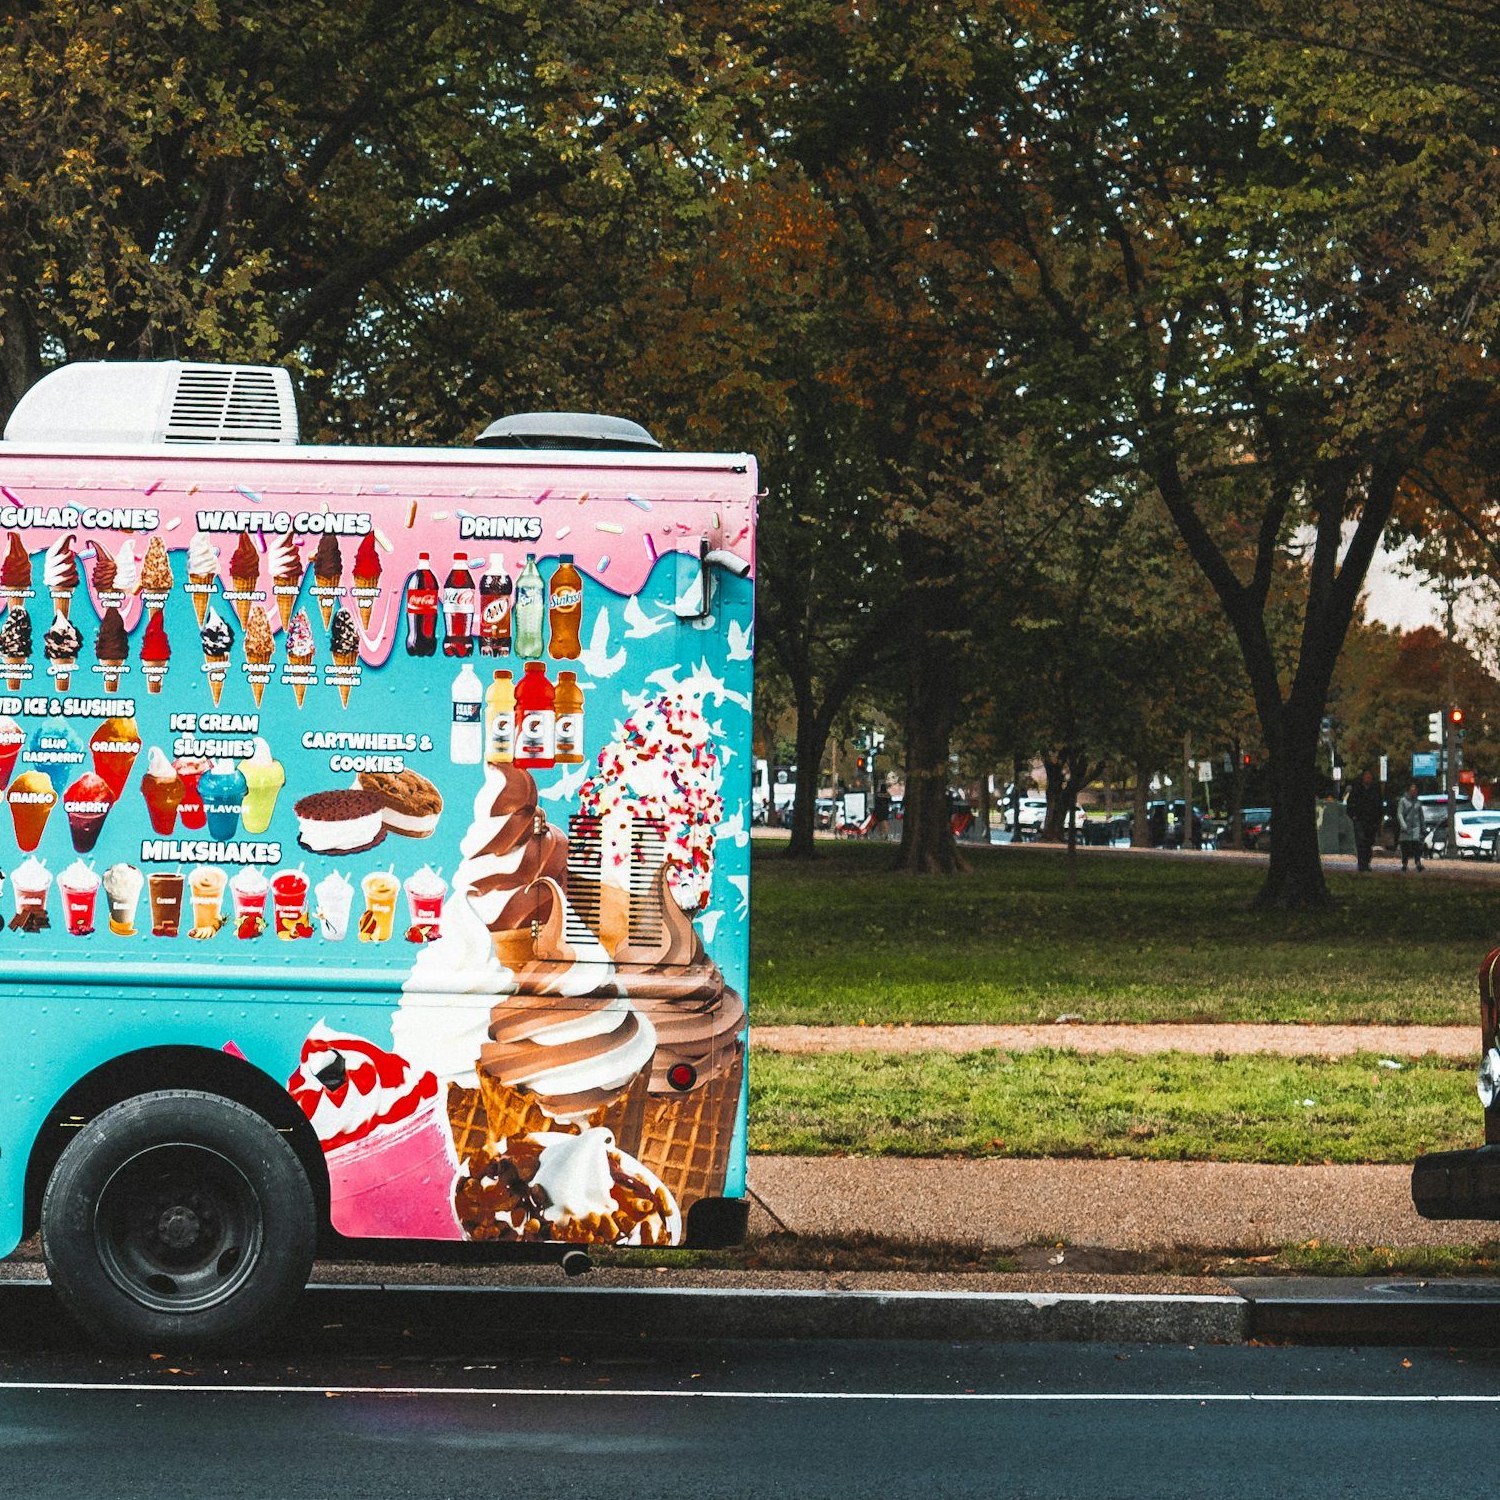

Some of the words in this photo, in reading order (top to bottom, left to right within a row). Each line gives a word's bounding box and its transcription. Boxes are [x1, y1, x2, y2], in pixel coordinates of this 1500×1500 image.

[82, 507, 159, 530] CONES
[293, 513, 371, 536] CONES
[460, 516, 542, 540] DRINKS
[184, 583, 218, 593] VANILLA
[223, 591, 266, 600] CHOCOLATE
[23, 697, 48, 716] ICE
[49, 698, 62, 716] &
[63, 698, 135, 718] SLUSHIES
[170, 713, 197, 732] ICE
[198, 714, 259, 733] CREAM
[40, 738, 68, 749] BLUE
[91, 741, 140, 753] ORANGE
[173, 739, 256, 758] SLUSHIES
[302, 733, 416, 752] CARTWHEELS
[419, 736, 433, 752] &
[22, 752, 85, 763] RASPBERRY
[329, 754, 405, 774] COOKIES
[9, 792, 54, 803] MANGO
[64, 802, 110, 813] CHERRY
[176, 804, 200, 812] ANY
[203, 804, 250, 814] FLAVOR
[141, 840, 282, 865] MILKSHAKES
